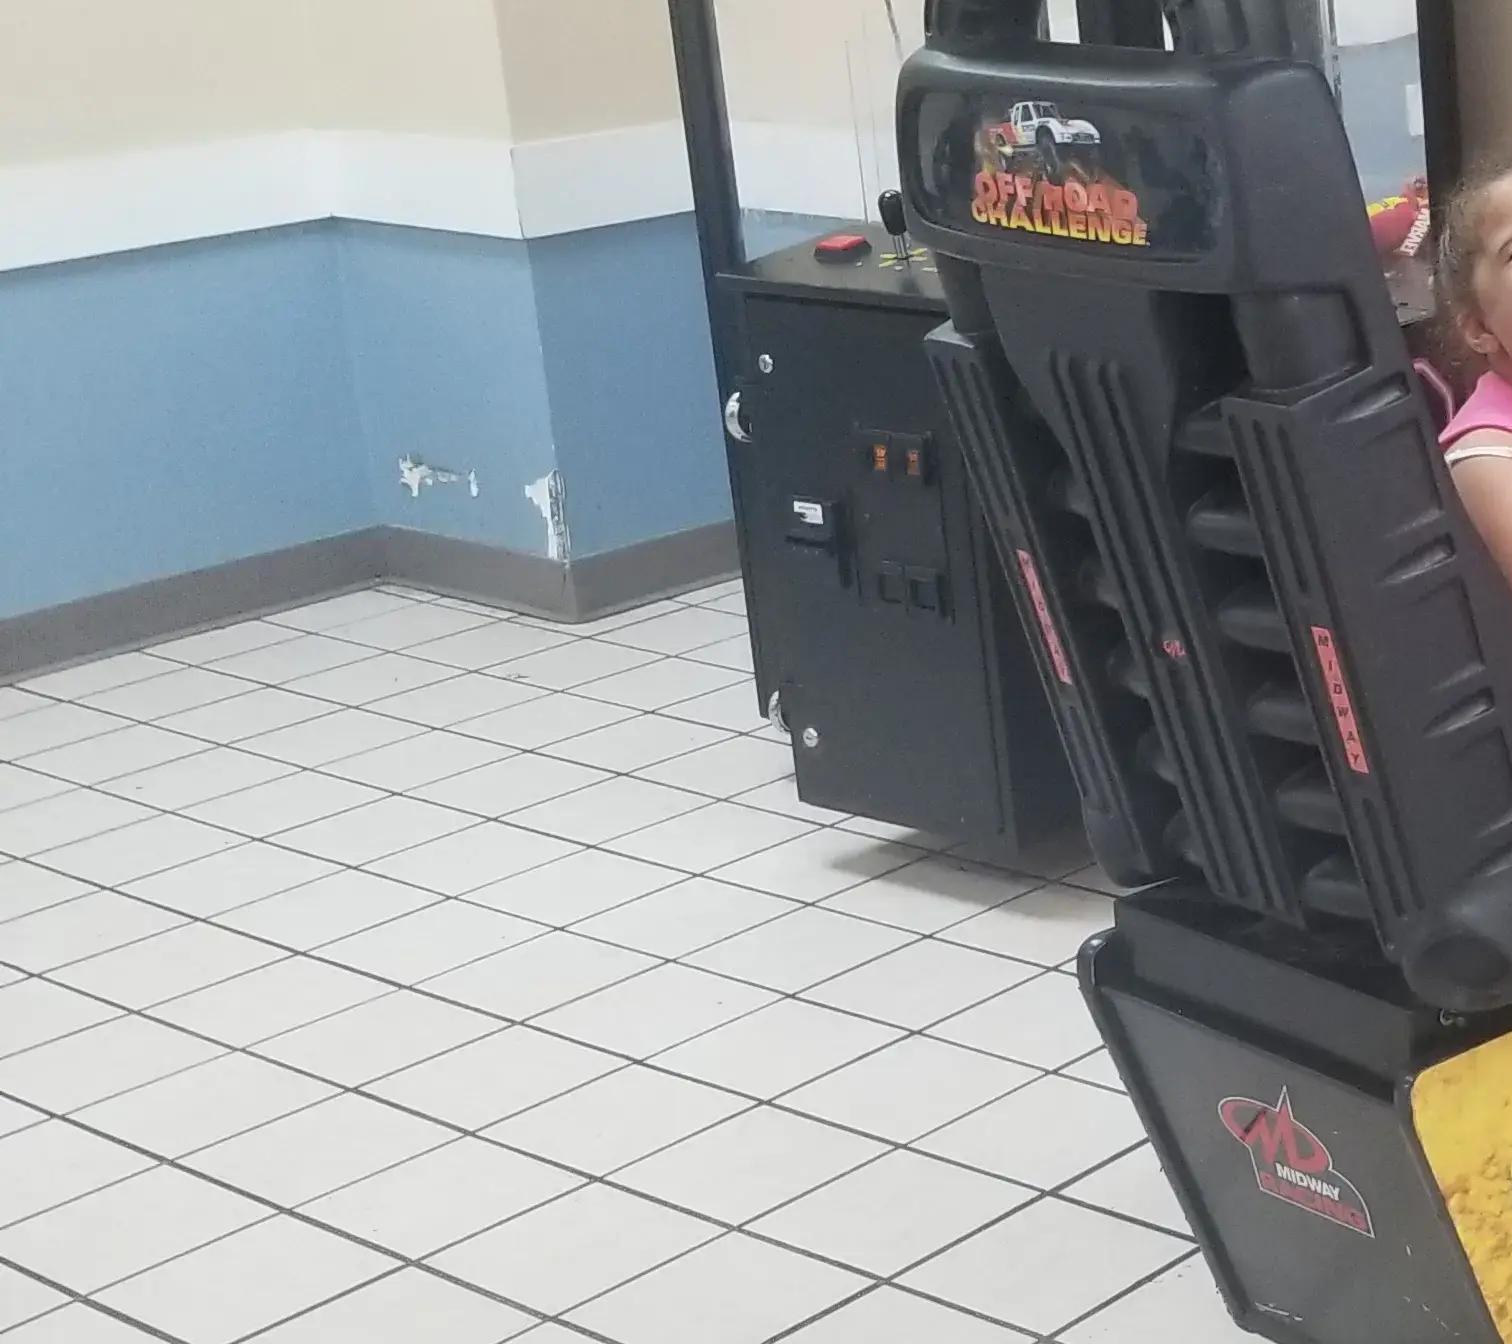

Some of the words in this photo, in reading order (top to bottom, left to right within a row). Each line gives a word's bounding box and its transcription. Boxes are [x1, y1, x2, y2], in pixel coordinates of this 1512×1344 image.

[975, 171, 1032, 207] OFF
[972, 197, 1148, 246] CHALLENGE
[1318, 635, 1360, 764] MIDWAY
[1275, 1162, 1341, 1202] MIDWAY
